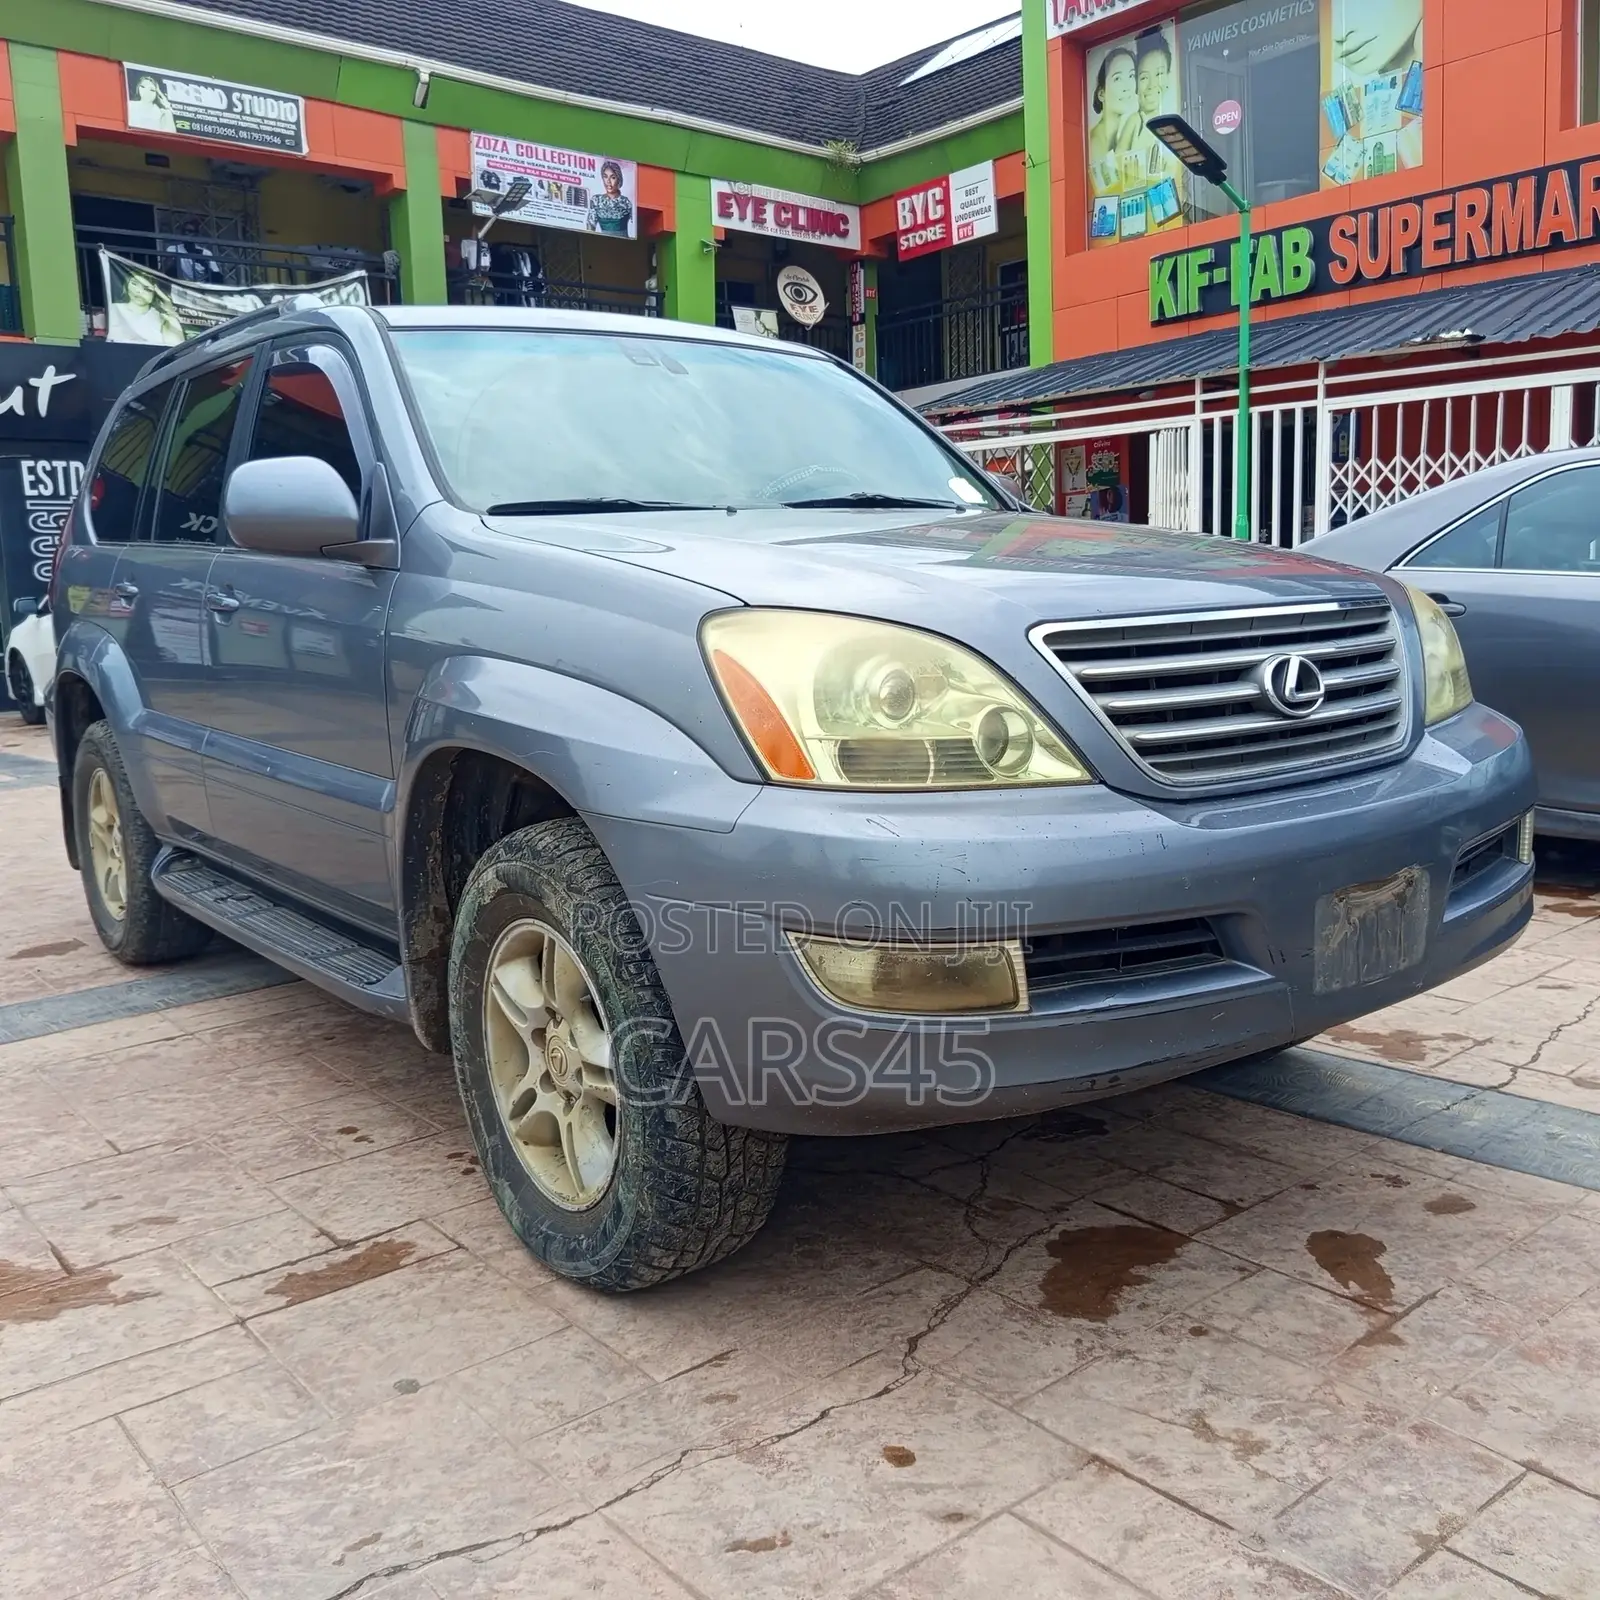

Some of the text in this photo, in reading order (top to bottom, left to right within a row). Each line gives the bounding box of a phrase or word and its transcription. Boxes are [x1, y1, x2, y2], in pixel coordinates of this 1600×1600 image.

[1188, 0, 1314, 51] YANNIES COSMETICS
[232, 92, 298, 122] STUDIO
[1214, 111, 1239, 125] OPEN
[475, 135, 596, 172] ZOZA COLLECTION
[960, 196, 986, 210] QUALITY
[964, 186, 979, 197] BEST
[718, 192, 767, 224] EYE
[774, 202, 850, 238] CLINIC
[897, 187, 944, 230] BYC
[955, 205, 992, 223] UNDERWEAR
[900, 223, 946, 250] STORE
[959, 225, 972, 238] BYC
[1150, 226, 1316, 322] KIF-FAB
[790, 303, 819, 314] EYE
[20, 460, 86, 496] ESTD
